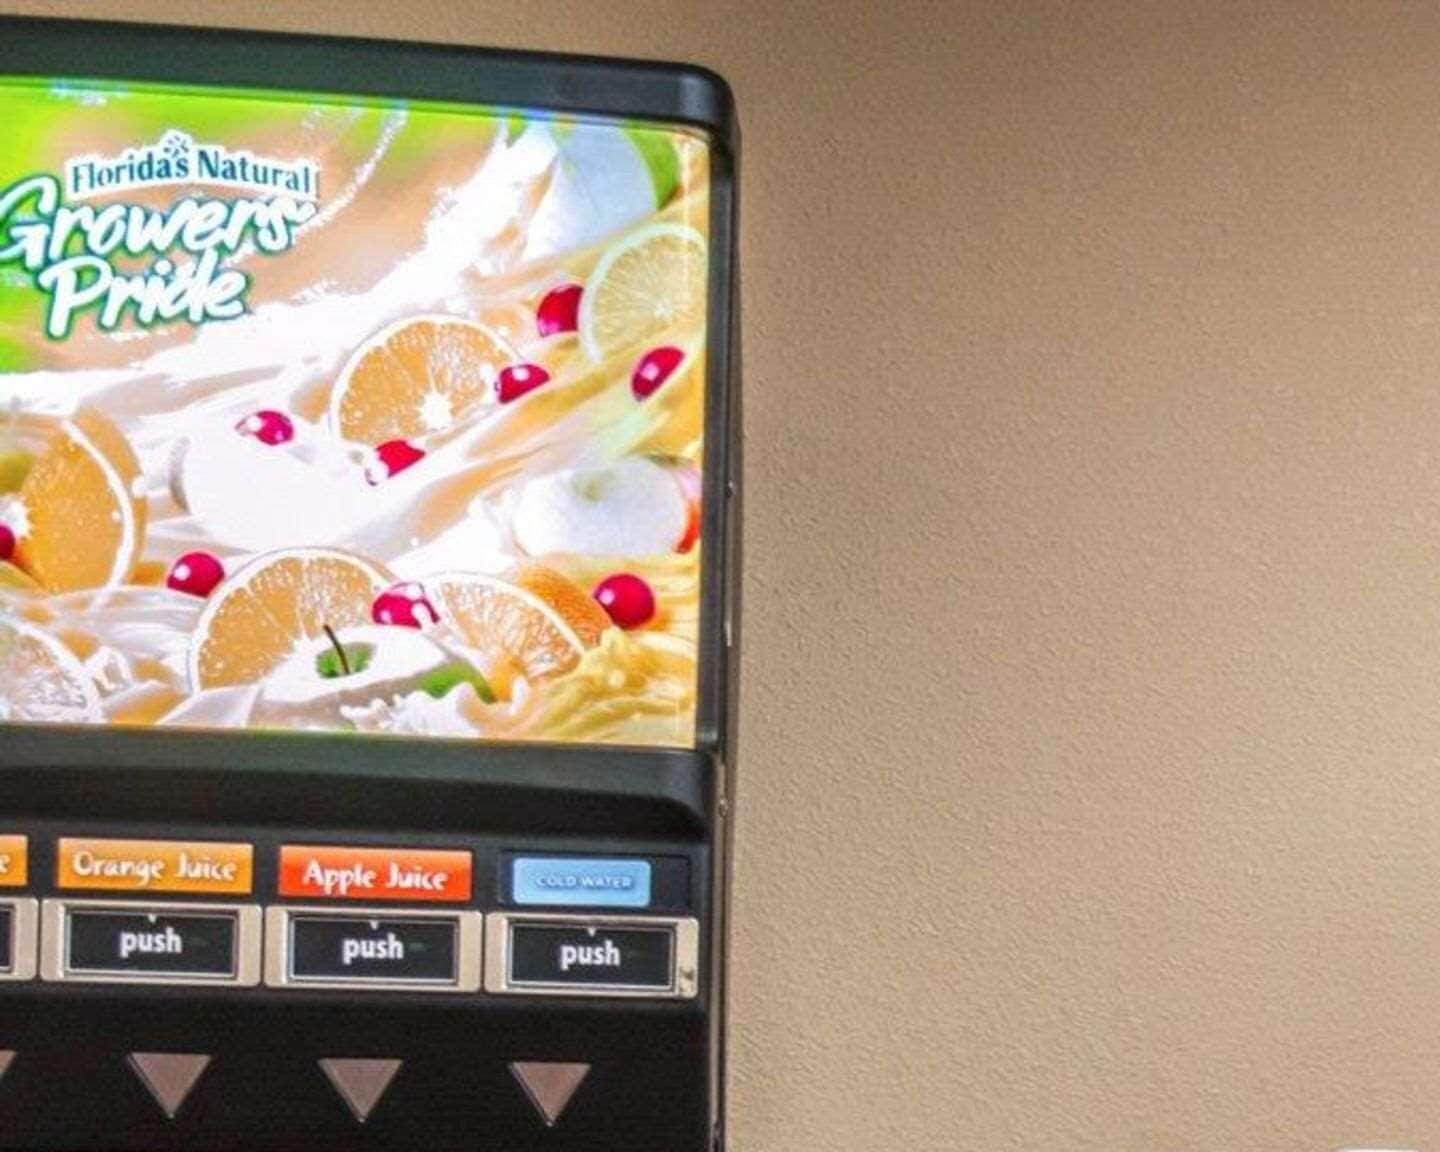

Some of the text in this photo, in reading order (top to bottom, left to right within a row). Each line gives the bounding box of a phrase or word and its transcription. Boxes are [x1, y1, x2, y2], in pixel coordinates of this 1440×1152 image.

[197, 150, 312, 194] Natural
[38, 250, 248, 339] Pride
[71, 851, 237, 885] Orange Juice
[302, 858, 449, 896] Apple Juice
[535, 873, 634, 892] COLD WATER
[119, 926, 183, 957] push
[342, 932, 405, 965] push
[559, 940, 621, 971] push
